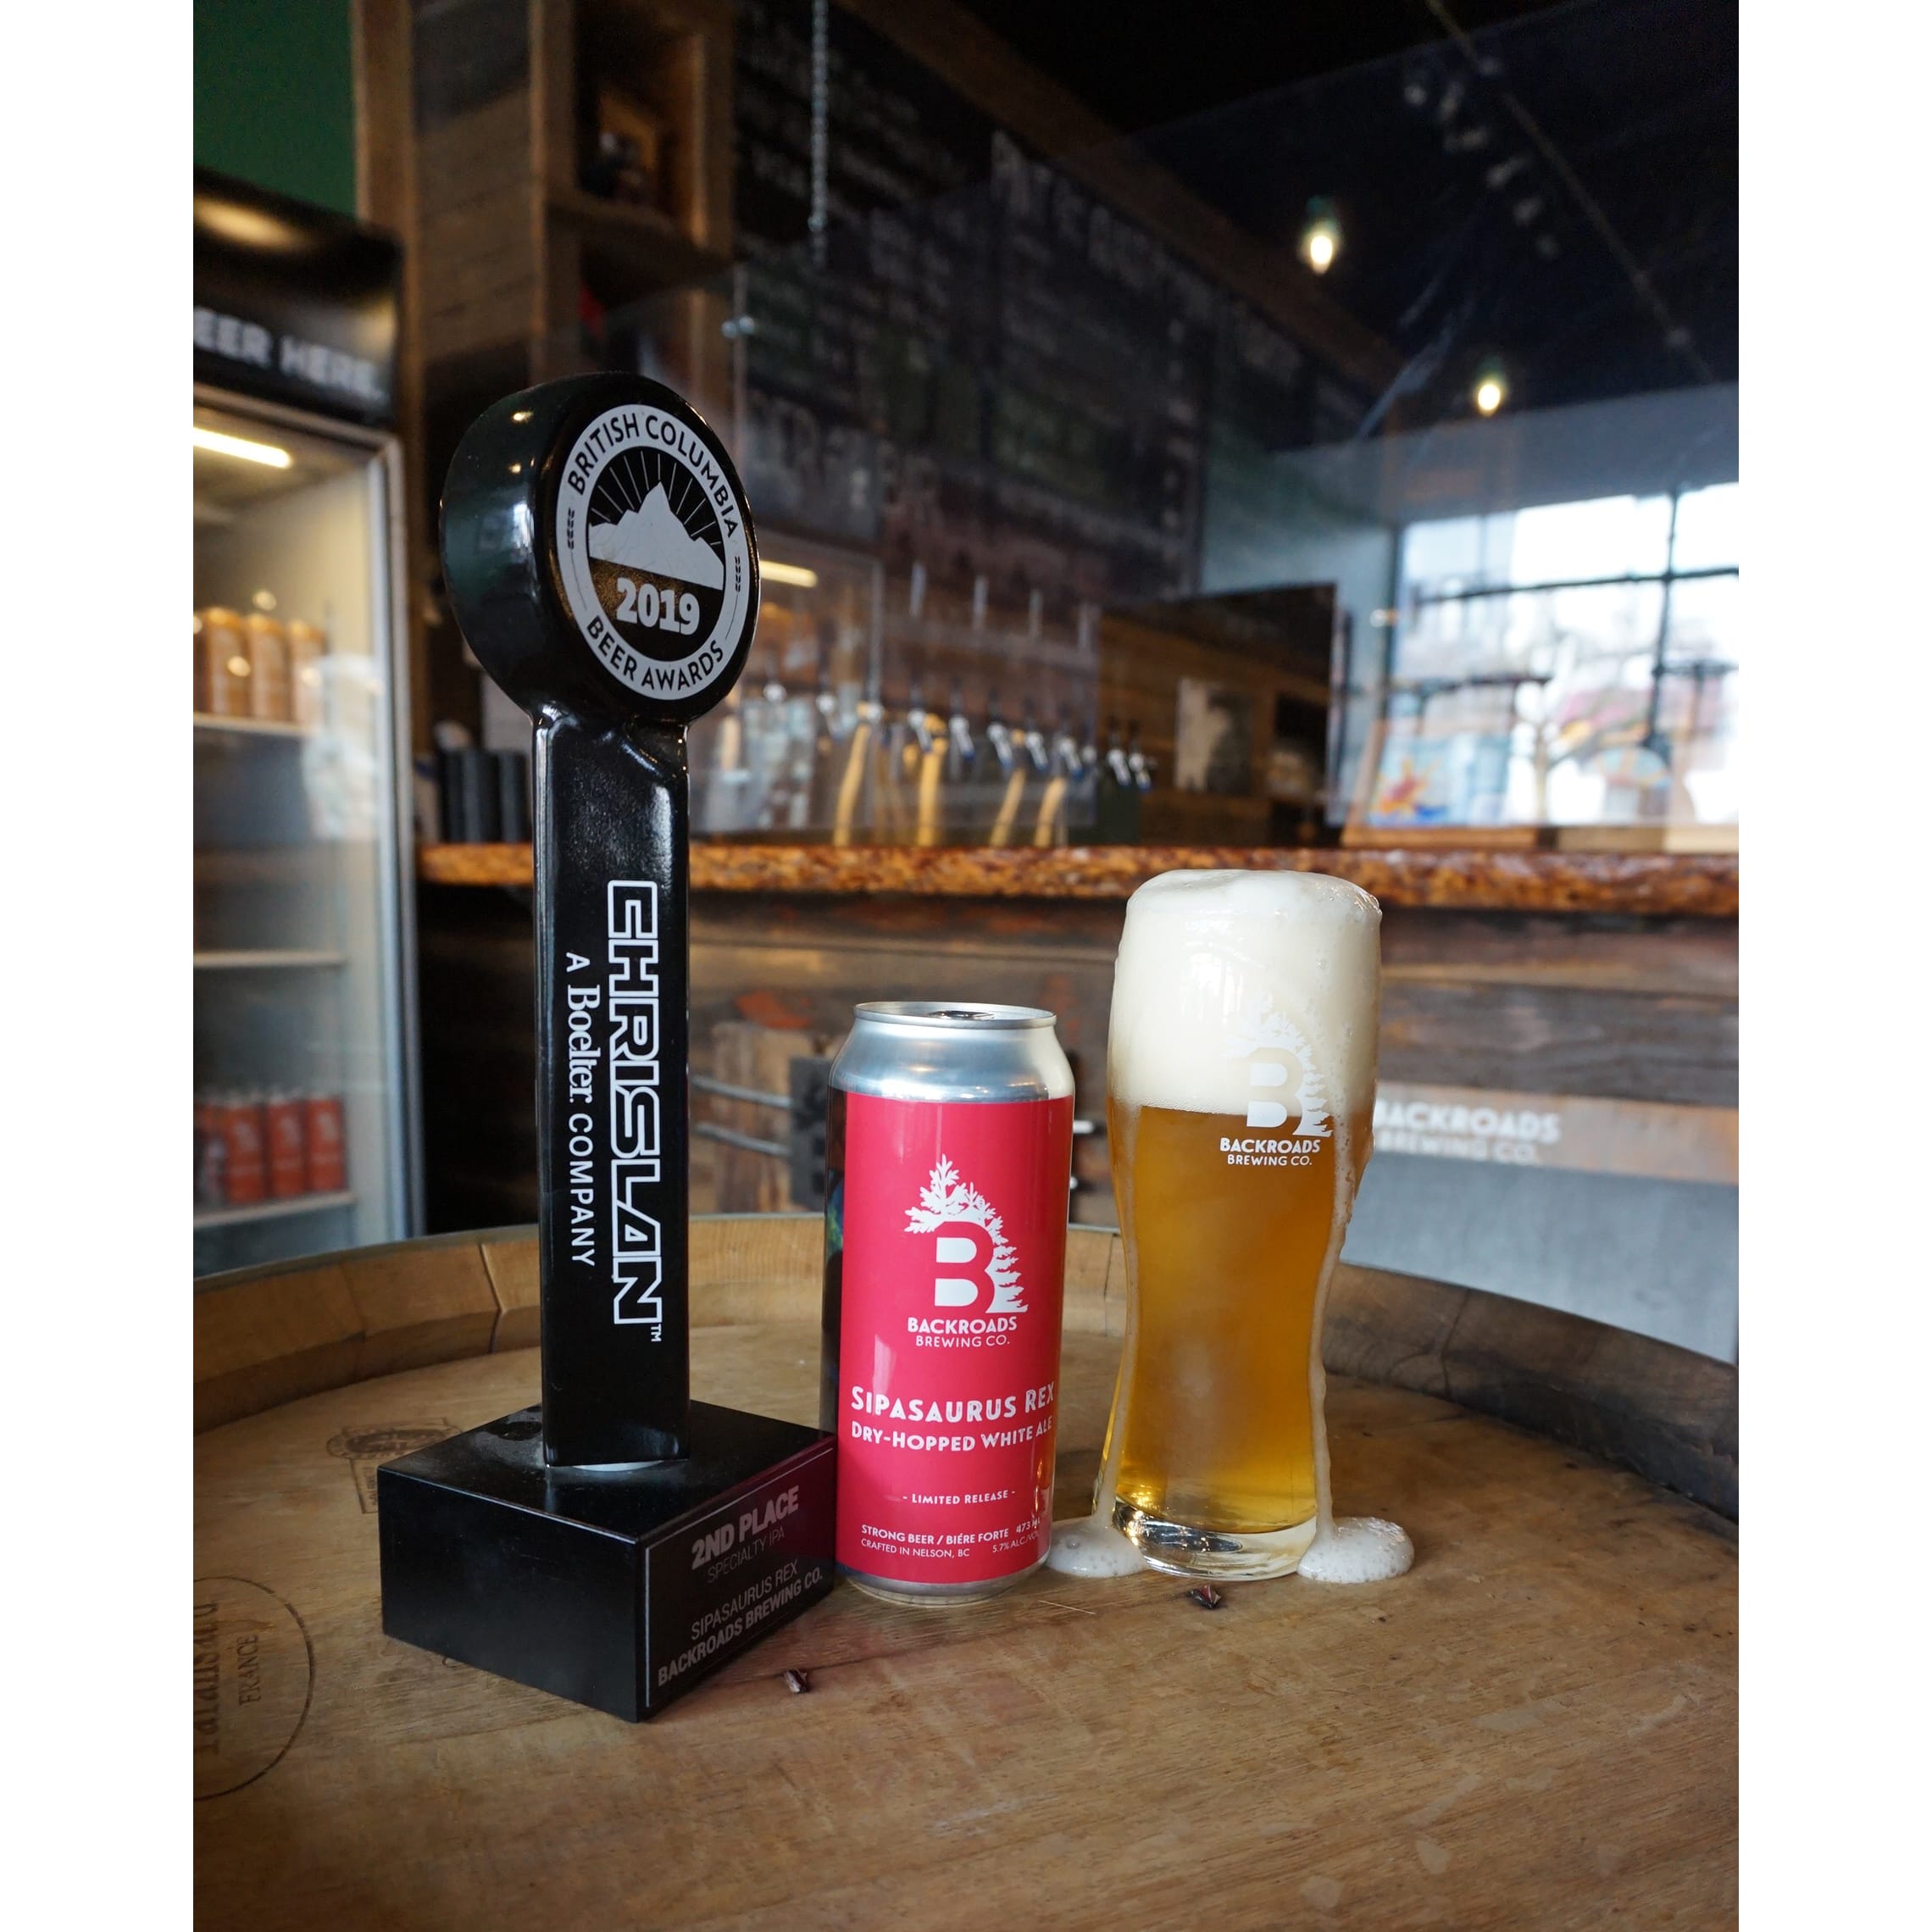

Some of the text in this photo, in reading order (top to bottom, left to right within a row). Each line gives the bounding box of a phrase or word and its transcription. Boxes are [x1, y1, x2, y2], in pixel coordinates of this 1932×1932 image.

[568, 413, 738, 538] BRITISH COLUMBIA
[616, 577, 700, 636] 2019
[586, 615, 724, 691] BEER AWARDS
[566, 952, 591, 972] A
[608, 880, 662, 1324] CHRISLAN
[1220, 1137, 1321, 1154] BACKROADS
[1228, 1155, 1312, 1165] BREWING CO.
[569, 1112, 595, 1267] COMPANY
[908, 1316, 1017, 1335] BACKROADS
[916, 1335, 1010, 1347] BREWING CO.
[851, 1382, 1055, 1423] SIPASAURUS REX
[852, 1415, 1052, 1452] DRY-HOPPED WHITE ALE
[912, 1491, 1008, 1504] LIMITED RELEASE
[691, 1485, 799, 1568] 2ND PLACE
[861, 1538, 897, 1553] CRAFTED
[899, 1545, 910, 1556] IN
[913, 1547, 955, 1558] NELSON,
[958, 1548, 970, 1557] BC
[862, 1524, 906, 1542] STRONG
[908, 1533, 935, 1545] BEER
[978, 1528, 1009, 1543] FORTE
[1016, 1521, 1030, 1534] 473
[708, 1527, 785, 1584] SPECIALTY IPA
[691, 1559, 798, 1641] SIPASAURUS REX
[658, 1567, 824, 1687] BACKROADS BREWING CO.
[236, 1634, 262, 1706] FRANCE
